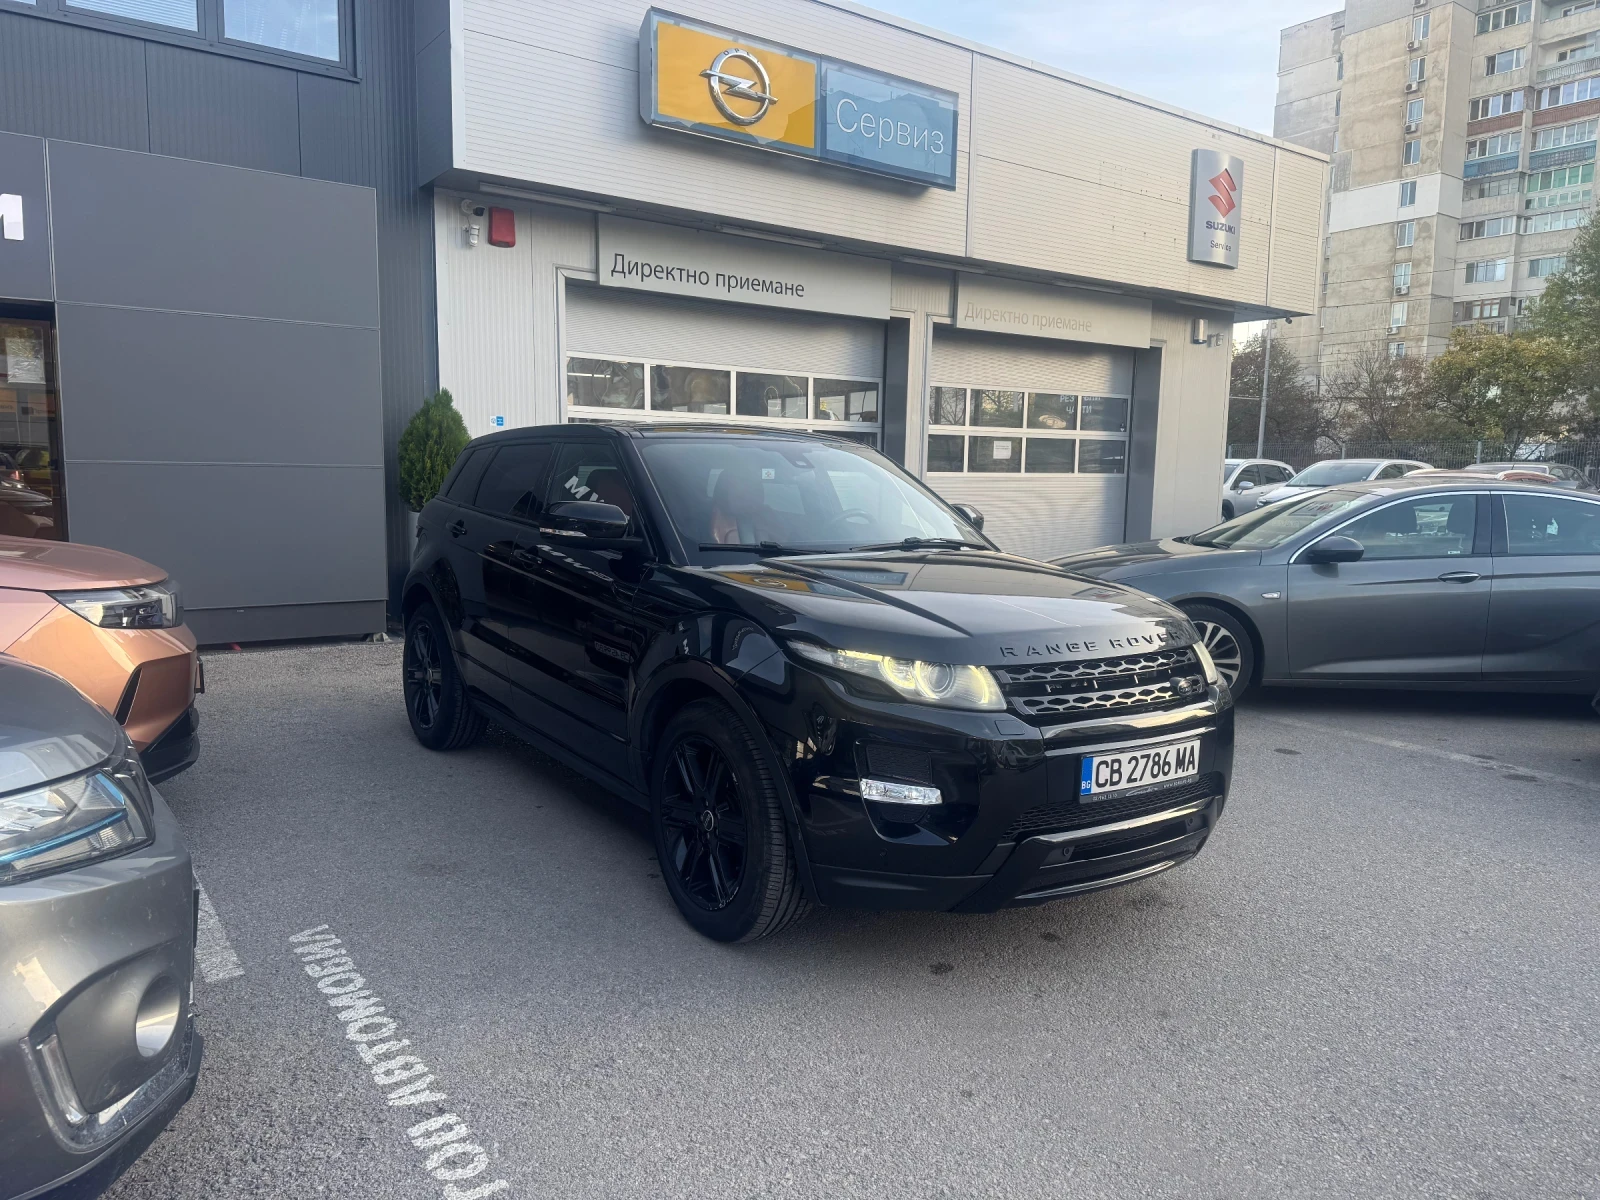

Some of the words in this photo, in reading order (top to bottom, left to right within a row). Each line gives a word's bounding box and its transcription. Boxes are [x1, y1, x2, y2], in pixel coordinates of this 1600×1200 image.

[836, 98, 944, 154] Сервиз
[1205, 220, 1236, 235] SUZUKI
[1210, 240, 1232, 252] Service
[611, 253, 710, 286] Директно
[715, 273, 805, 298] приемане
[964, 301, 1029, 325] Директно
[1032, 313, 1093, 333] приемане
[999, 641, 1099, 658] RANGE
[1108, 631, 1182, 650] ROVER
[1095, 758, 1122, 789] CB
[1126, 749, 1172, 784] 2786
[1174, 744, 1196, 775] MA
[1081, 780, 1091, 790] BG
